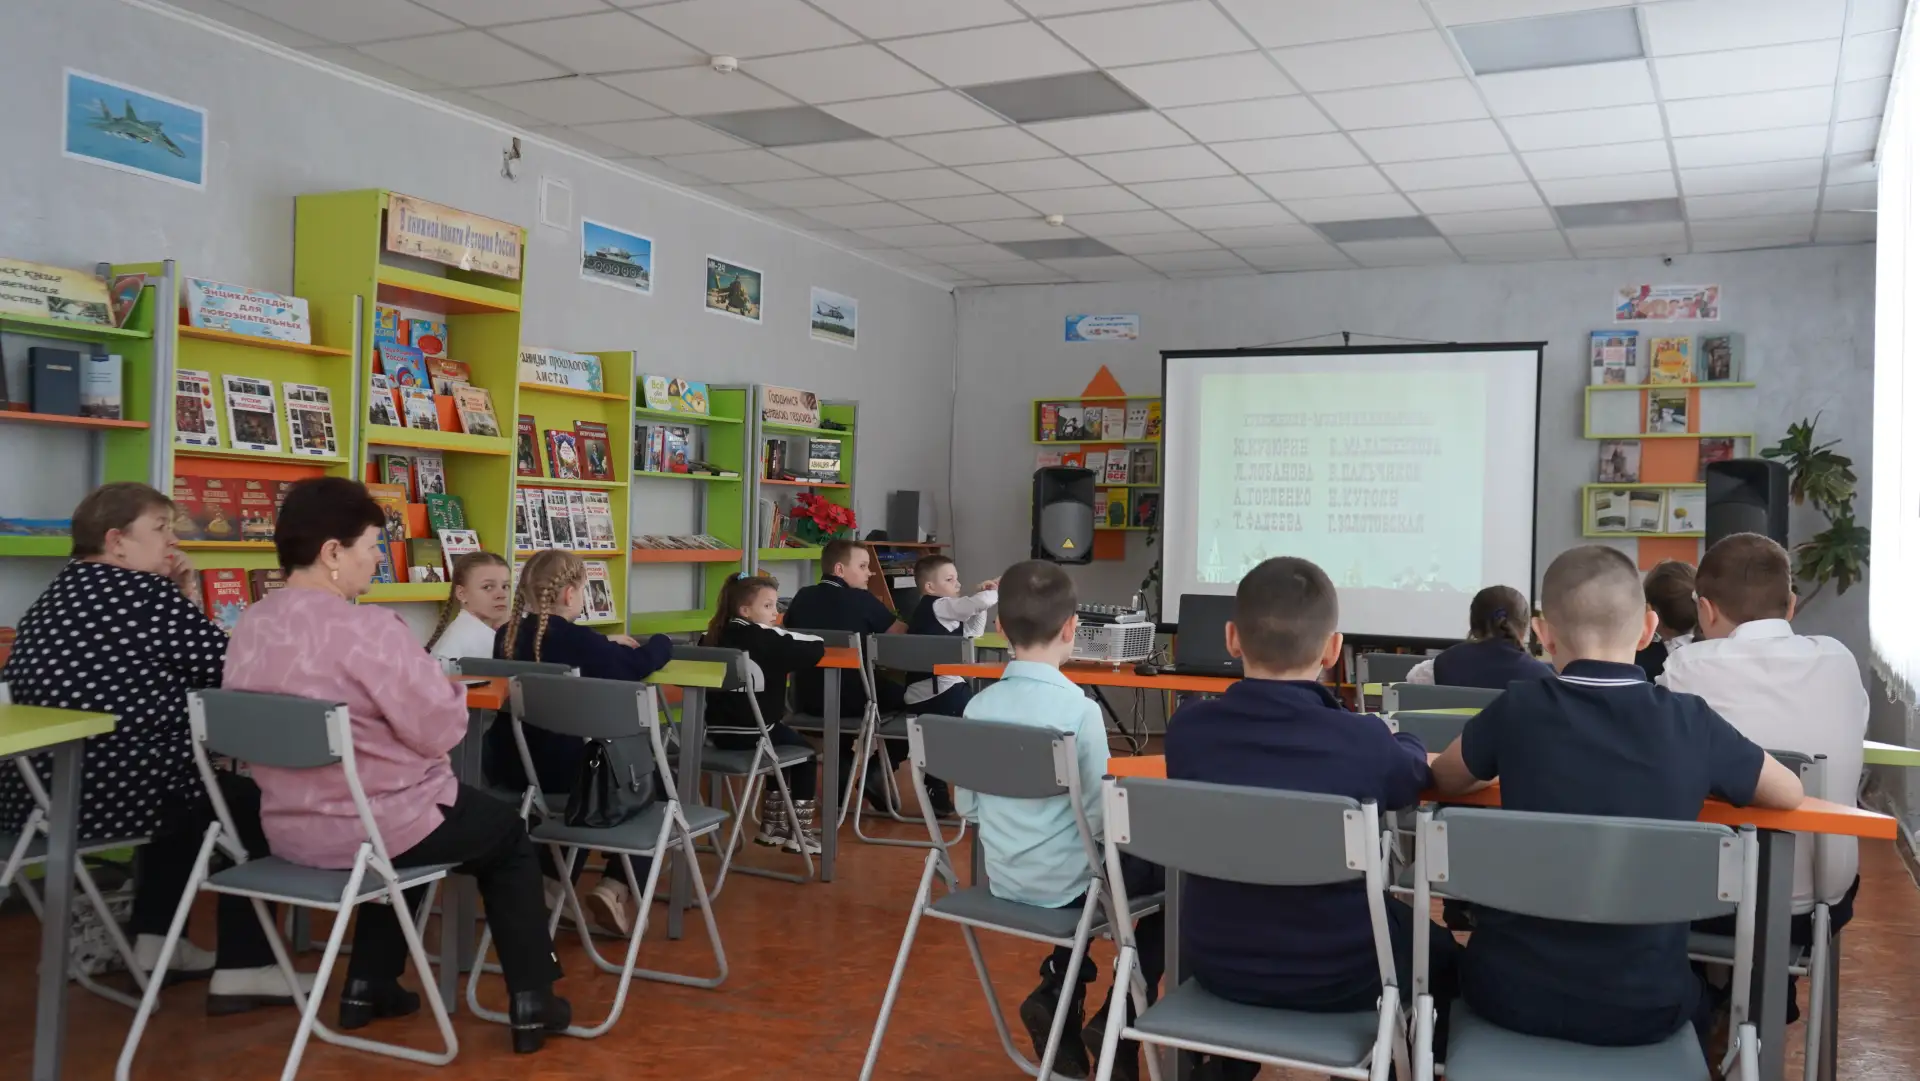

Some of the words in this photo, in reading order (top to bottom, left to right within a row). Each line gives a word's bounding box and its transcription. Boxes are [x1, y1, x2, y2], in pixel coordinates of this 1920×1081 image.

[200, 306, 302, 330] ЛЮБОЗНАТЕЛЬНЫХ
[239, 303, 262, 313] ДЛЯ
[1233, 487, 1311, 507] А.ГОРЛЕНКО
[1233, 510, 1303, 531] Т.ФАДЕЕВА
